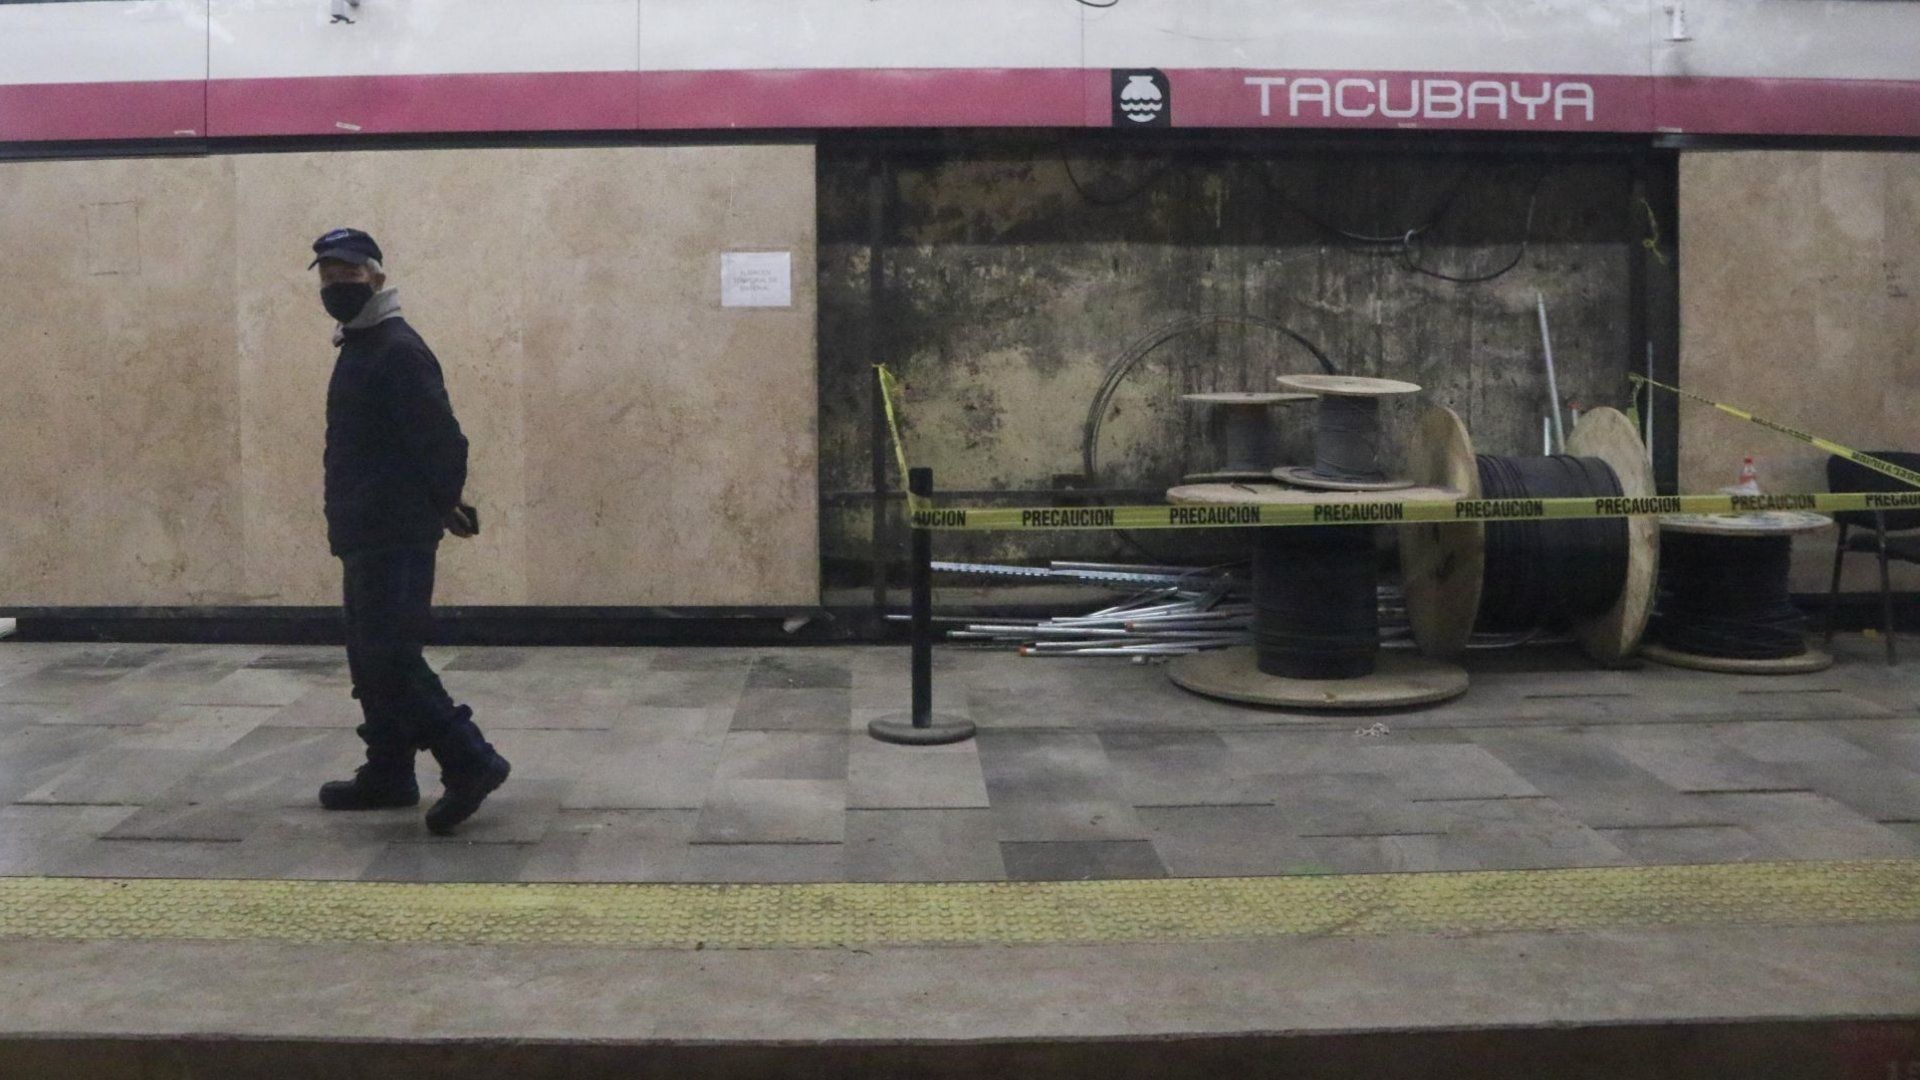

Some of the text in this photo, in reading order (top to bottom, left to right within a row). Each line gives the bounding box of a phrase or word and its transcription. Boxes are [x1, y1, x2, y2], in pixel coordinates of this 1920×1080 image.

[1244, 77, 1594, 121] TACUBAYA
[1022, 509, 1114, 526] PRECAUCION
[1170, 506, 1260, 524] PRECAUCION
[1314, 503, 1403, 521] PRECAUCION
[1456, 500, 1543, 518] PRECAUCION
[1595, 497, 1681, 514] PRECAUCION
[1731, 494, 1816, 510] PRECAUCION
[1865, 493, 1920, 508] PRECAU
